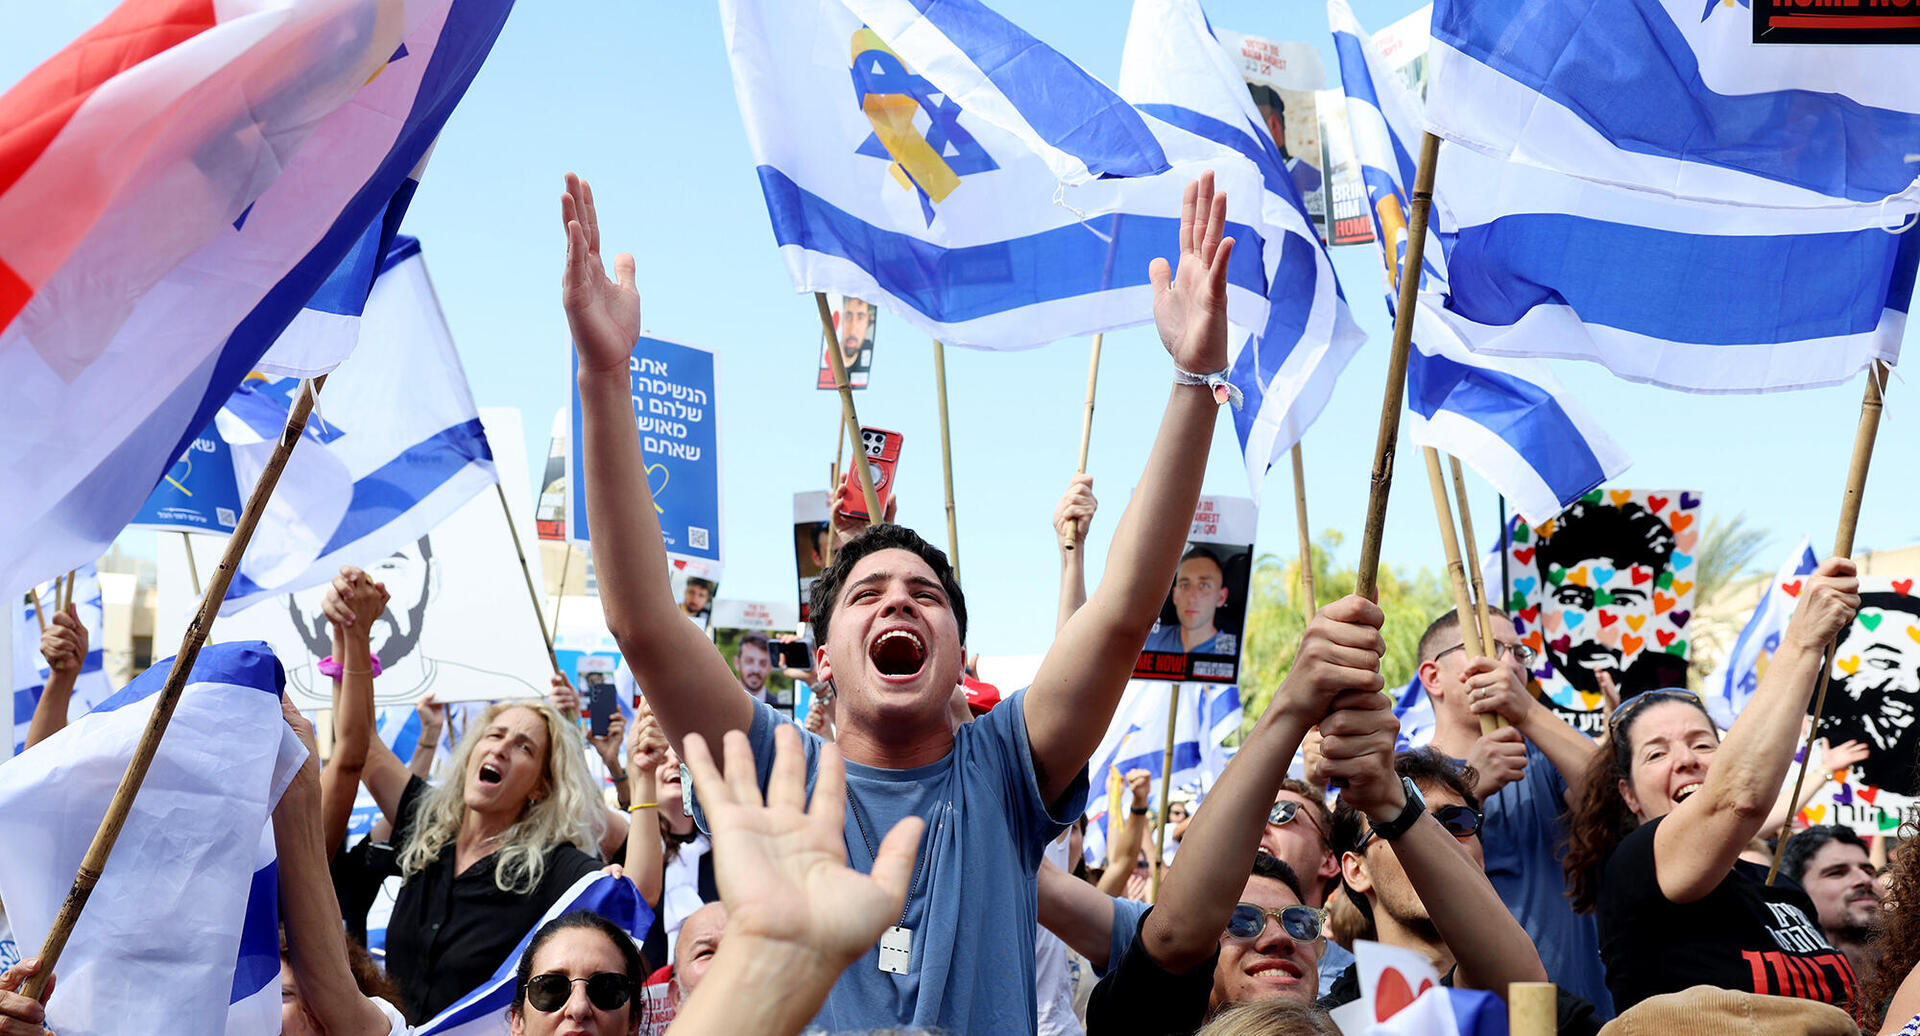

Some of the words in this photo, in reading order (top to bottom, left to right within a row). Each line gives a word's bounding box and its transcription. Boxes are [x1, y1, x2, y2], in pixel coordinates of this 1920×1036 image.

[1332, 182, 1364, 203] BRIN
[1333, 199, 1360, 220] HIM
[639, 377, 707, 405] הנשימה
[649, 398, 702, 422] שלהם
[637, 416, 687, 439] מאוש
[644, 437, 701, 461] שאתם
[1156, 654, 1187, 673] NOW!
